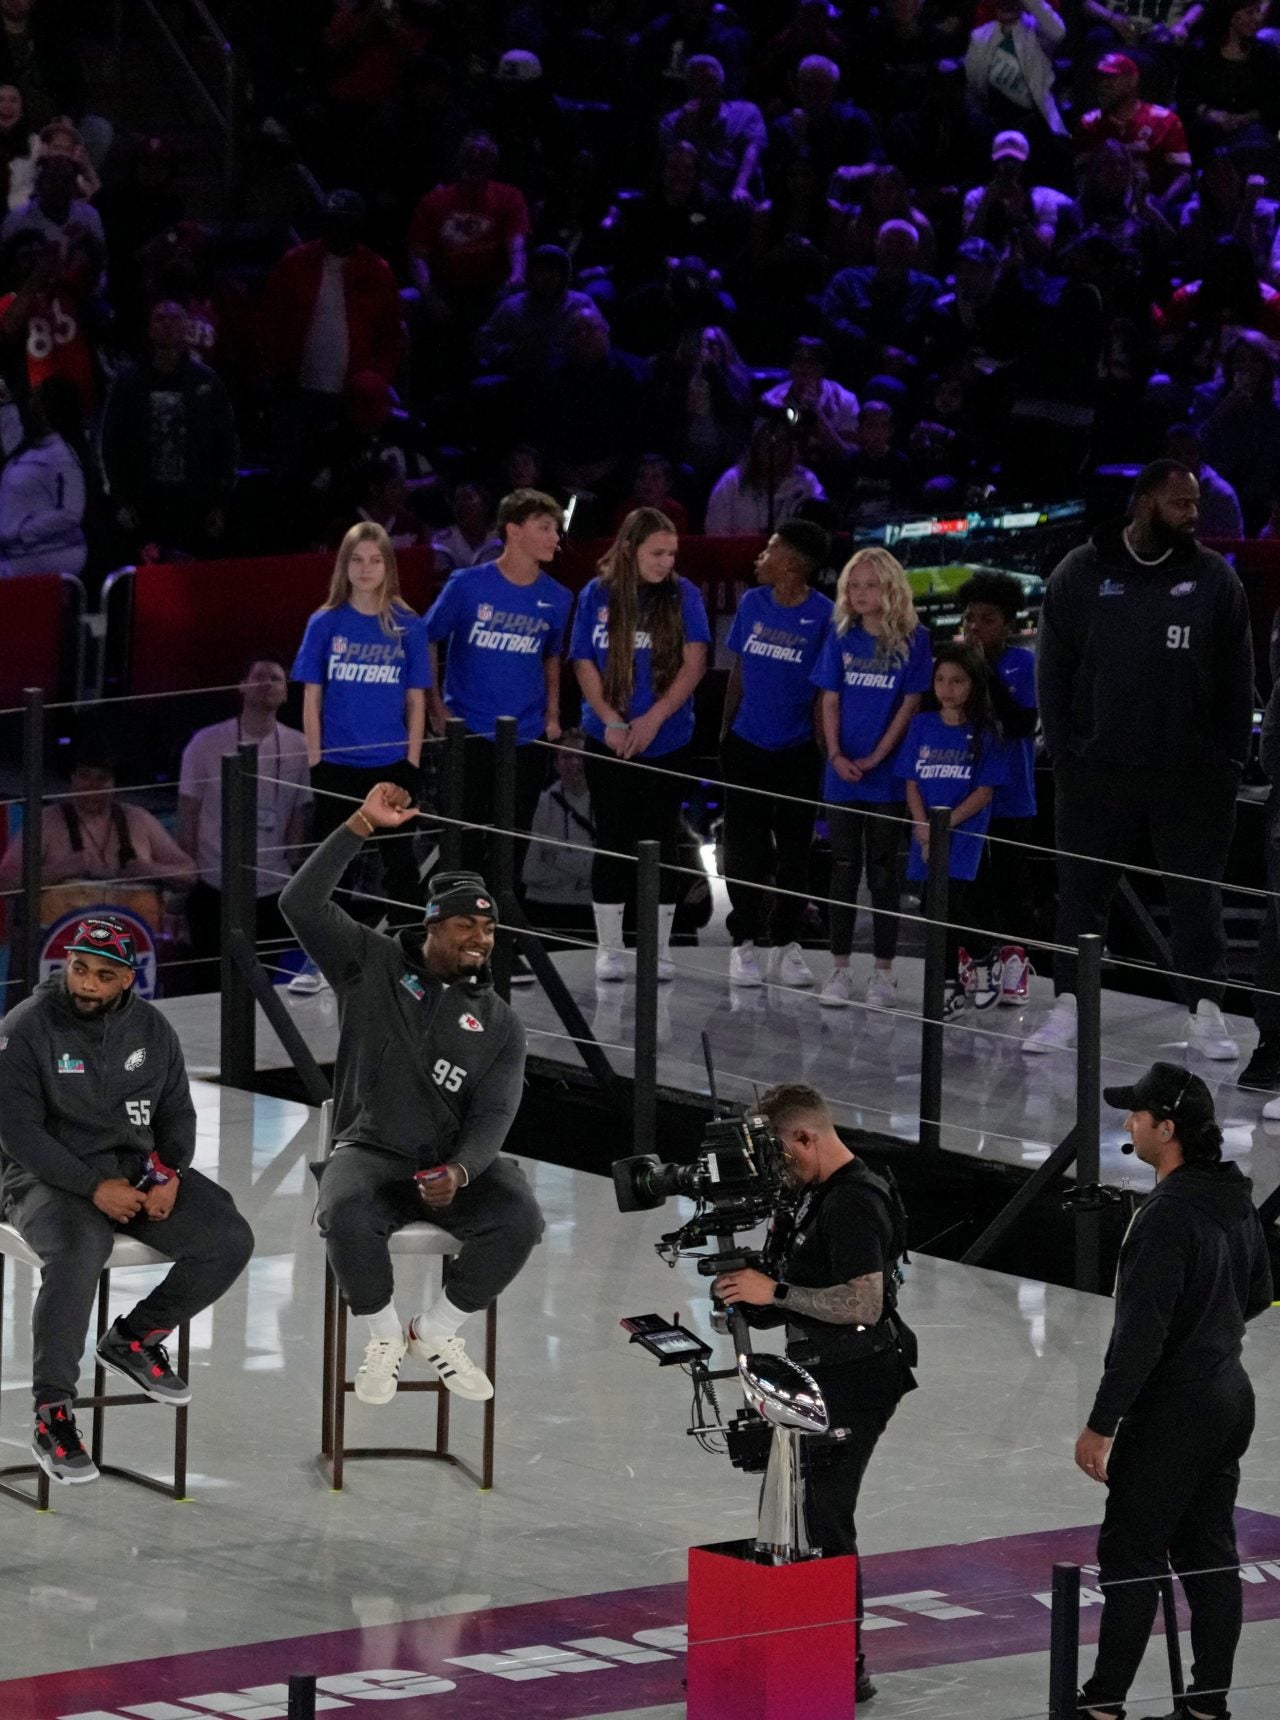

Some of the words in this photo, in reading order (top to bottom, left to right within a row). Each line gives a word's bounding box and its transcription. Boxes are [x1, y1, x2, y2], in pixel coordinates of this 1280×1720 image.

[467, 621, 541, 654] FOOTBALL
[742, 633, 803, 664] FOOTBALL
[1166, 624, 1192, 649] 91
[327, 654, 402, 684] FOOTBALL
[915, 759, 972, 780] FOOTBALL
[431, 1058, 468, 1093] 95
[125, 1099, 152, 1127] 55
